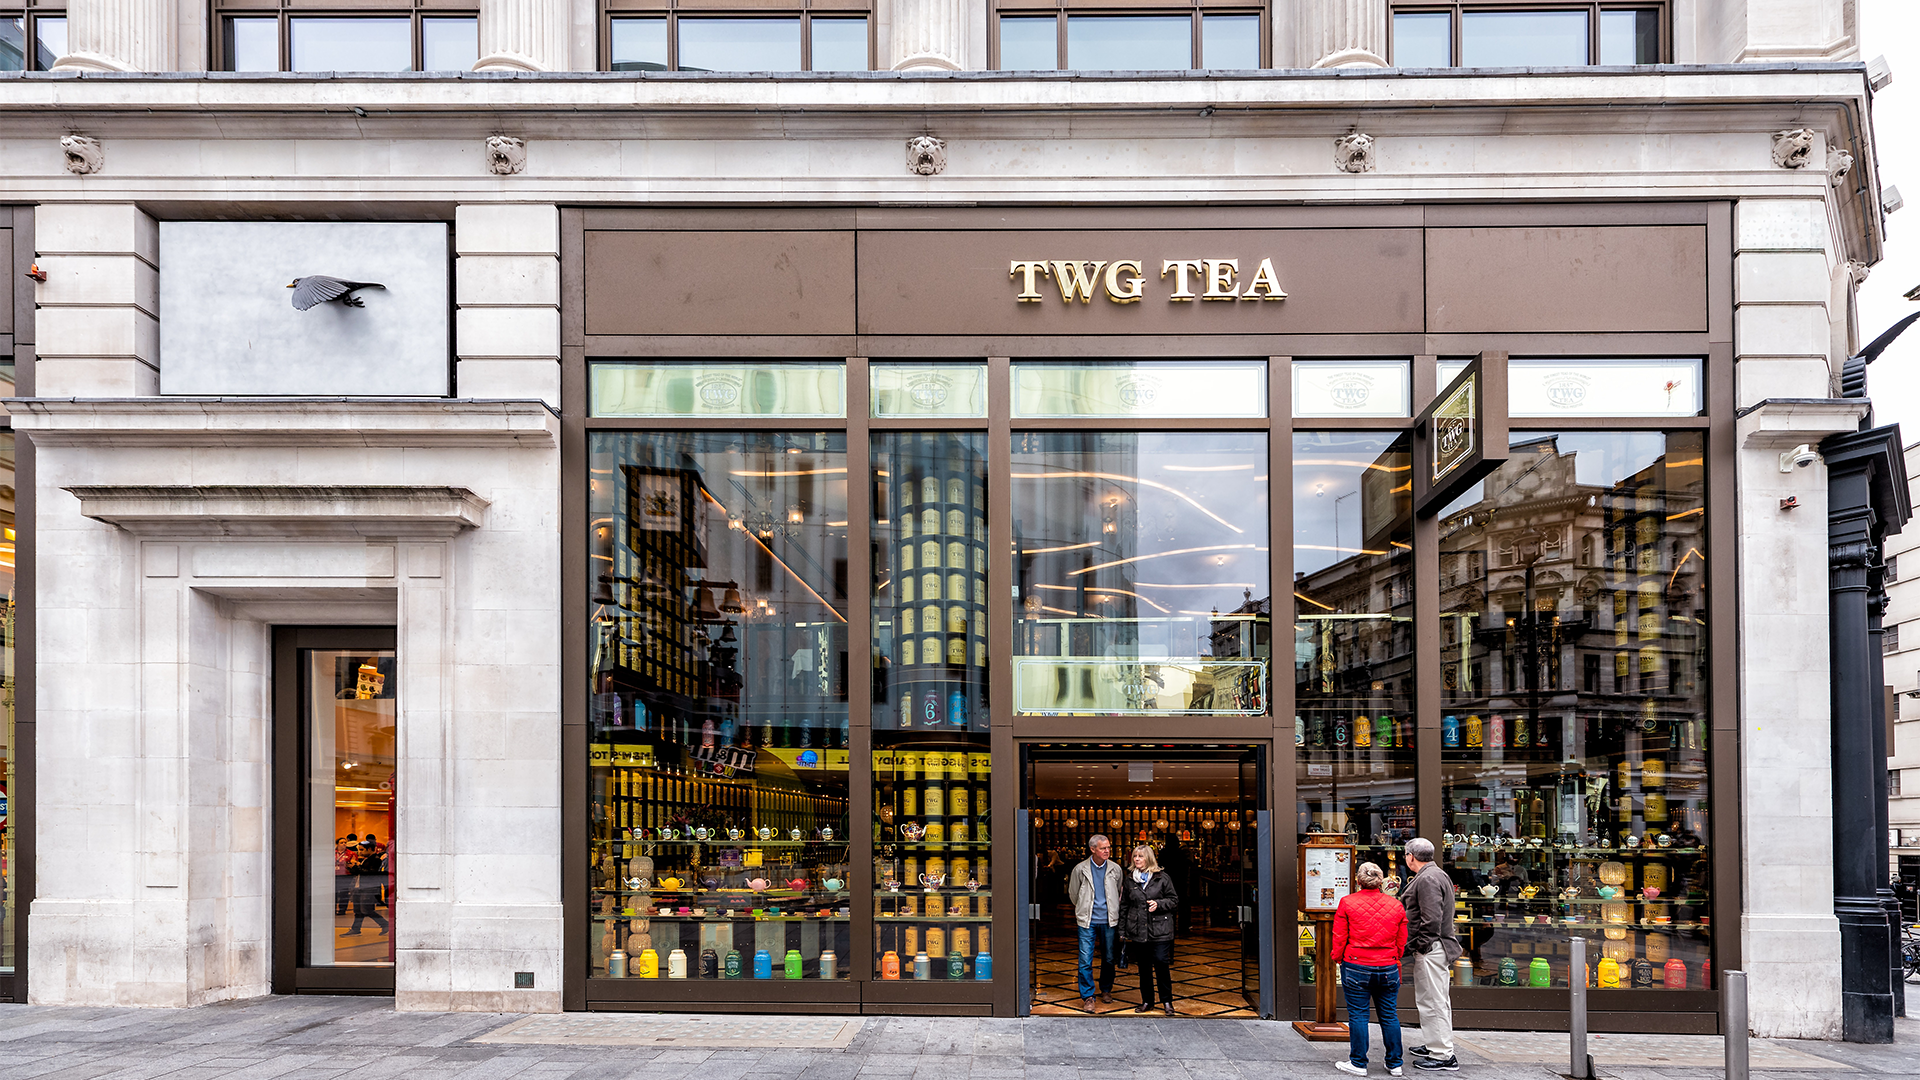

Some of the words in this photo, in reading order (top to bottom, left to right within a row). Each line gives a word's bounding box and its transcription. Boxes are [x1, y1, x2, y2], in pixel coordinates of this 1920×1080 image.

[1009, 259, 1147, 304] TWG
[1161, 257, 1289, 302] TEA
[702, 389, 734, 399] TWG
[913, 389, 944, 399] TWG
[1122, 389, 1154, 400] TWG
[1333, 388, 1367, 398] TWG
[1549, 387, 1583, 398] TWG
[1442, 422, 1463, 448] TWG
[1123, 684, 1157, 695] TWG
[925, 703, 936, 720] 6
[1335, 727, 1346, 742] 6
[1446, 727, 1458, 742] 4
[1493, 727, 1503, 743] 8
